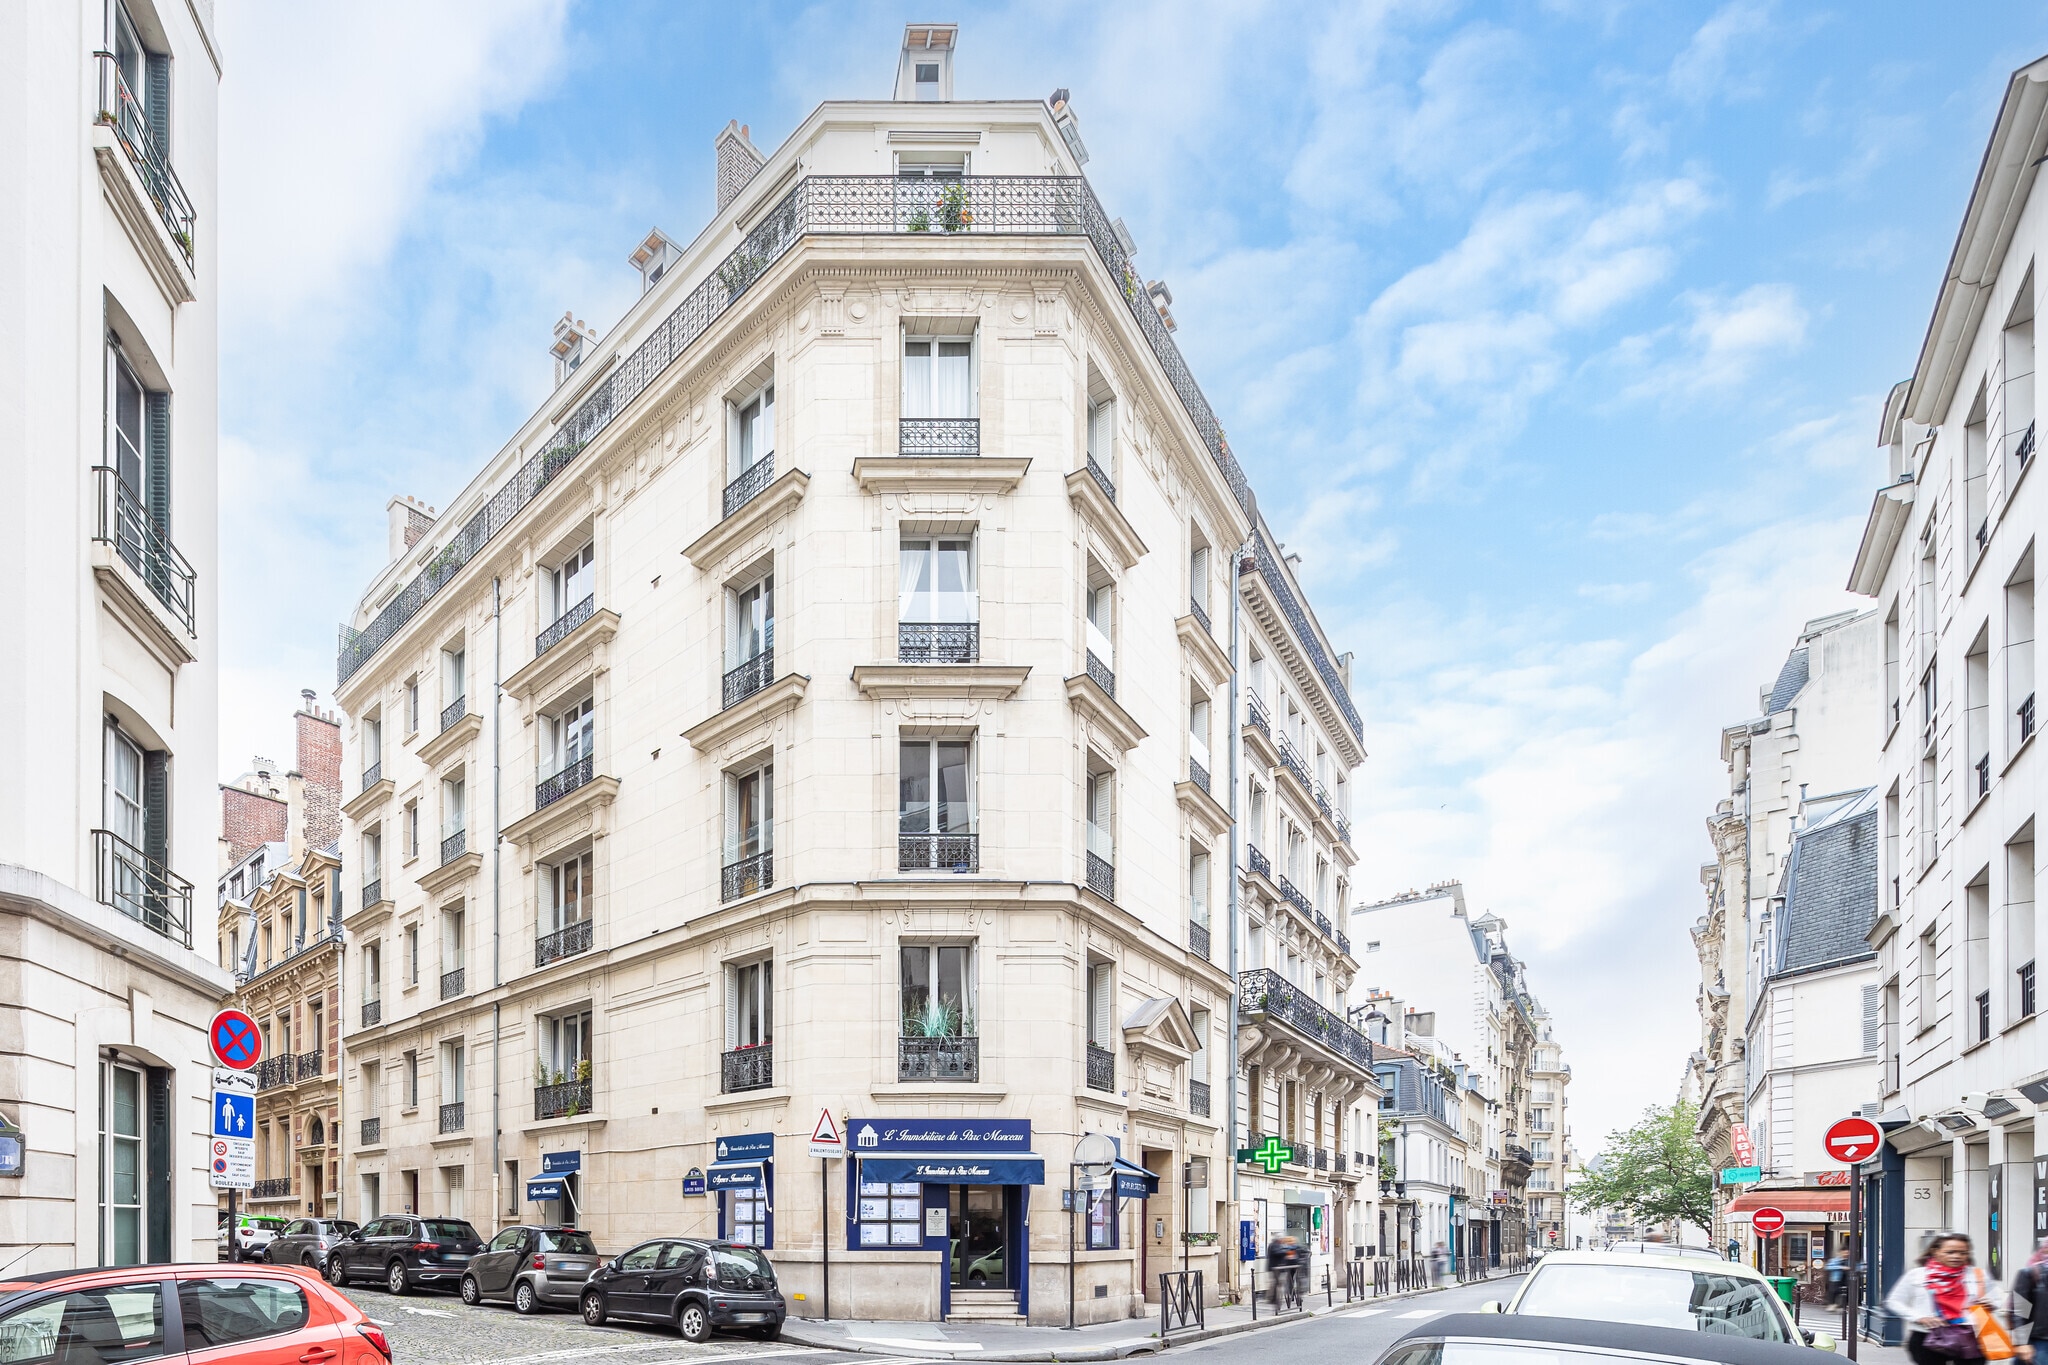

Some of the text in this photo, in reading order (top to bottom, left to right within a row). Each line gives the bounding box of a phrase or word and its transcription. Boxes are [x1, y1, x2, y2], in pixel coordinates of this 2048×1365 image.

[946, 1130, 958, 1141] du
[960, 1129, 981, 1141] Parc
[983, 1129, 1024, 1141] Monceau
[1734, 1127, 1751, 1166] TABAC
[956, 1165, 967, 1175] Parc
[967, 1166, 990, 1175] Monceau
[1913, 1188, 1931, 1200] 53
[1827, 1212, 1851, 1222] TABA
